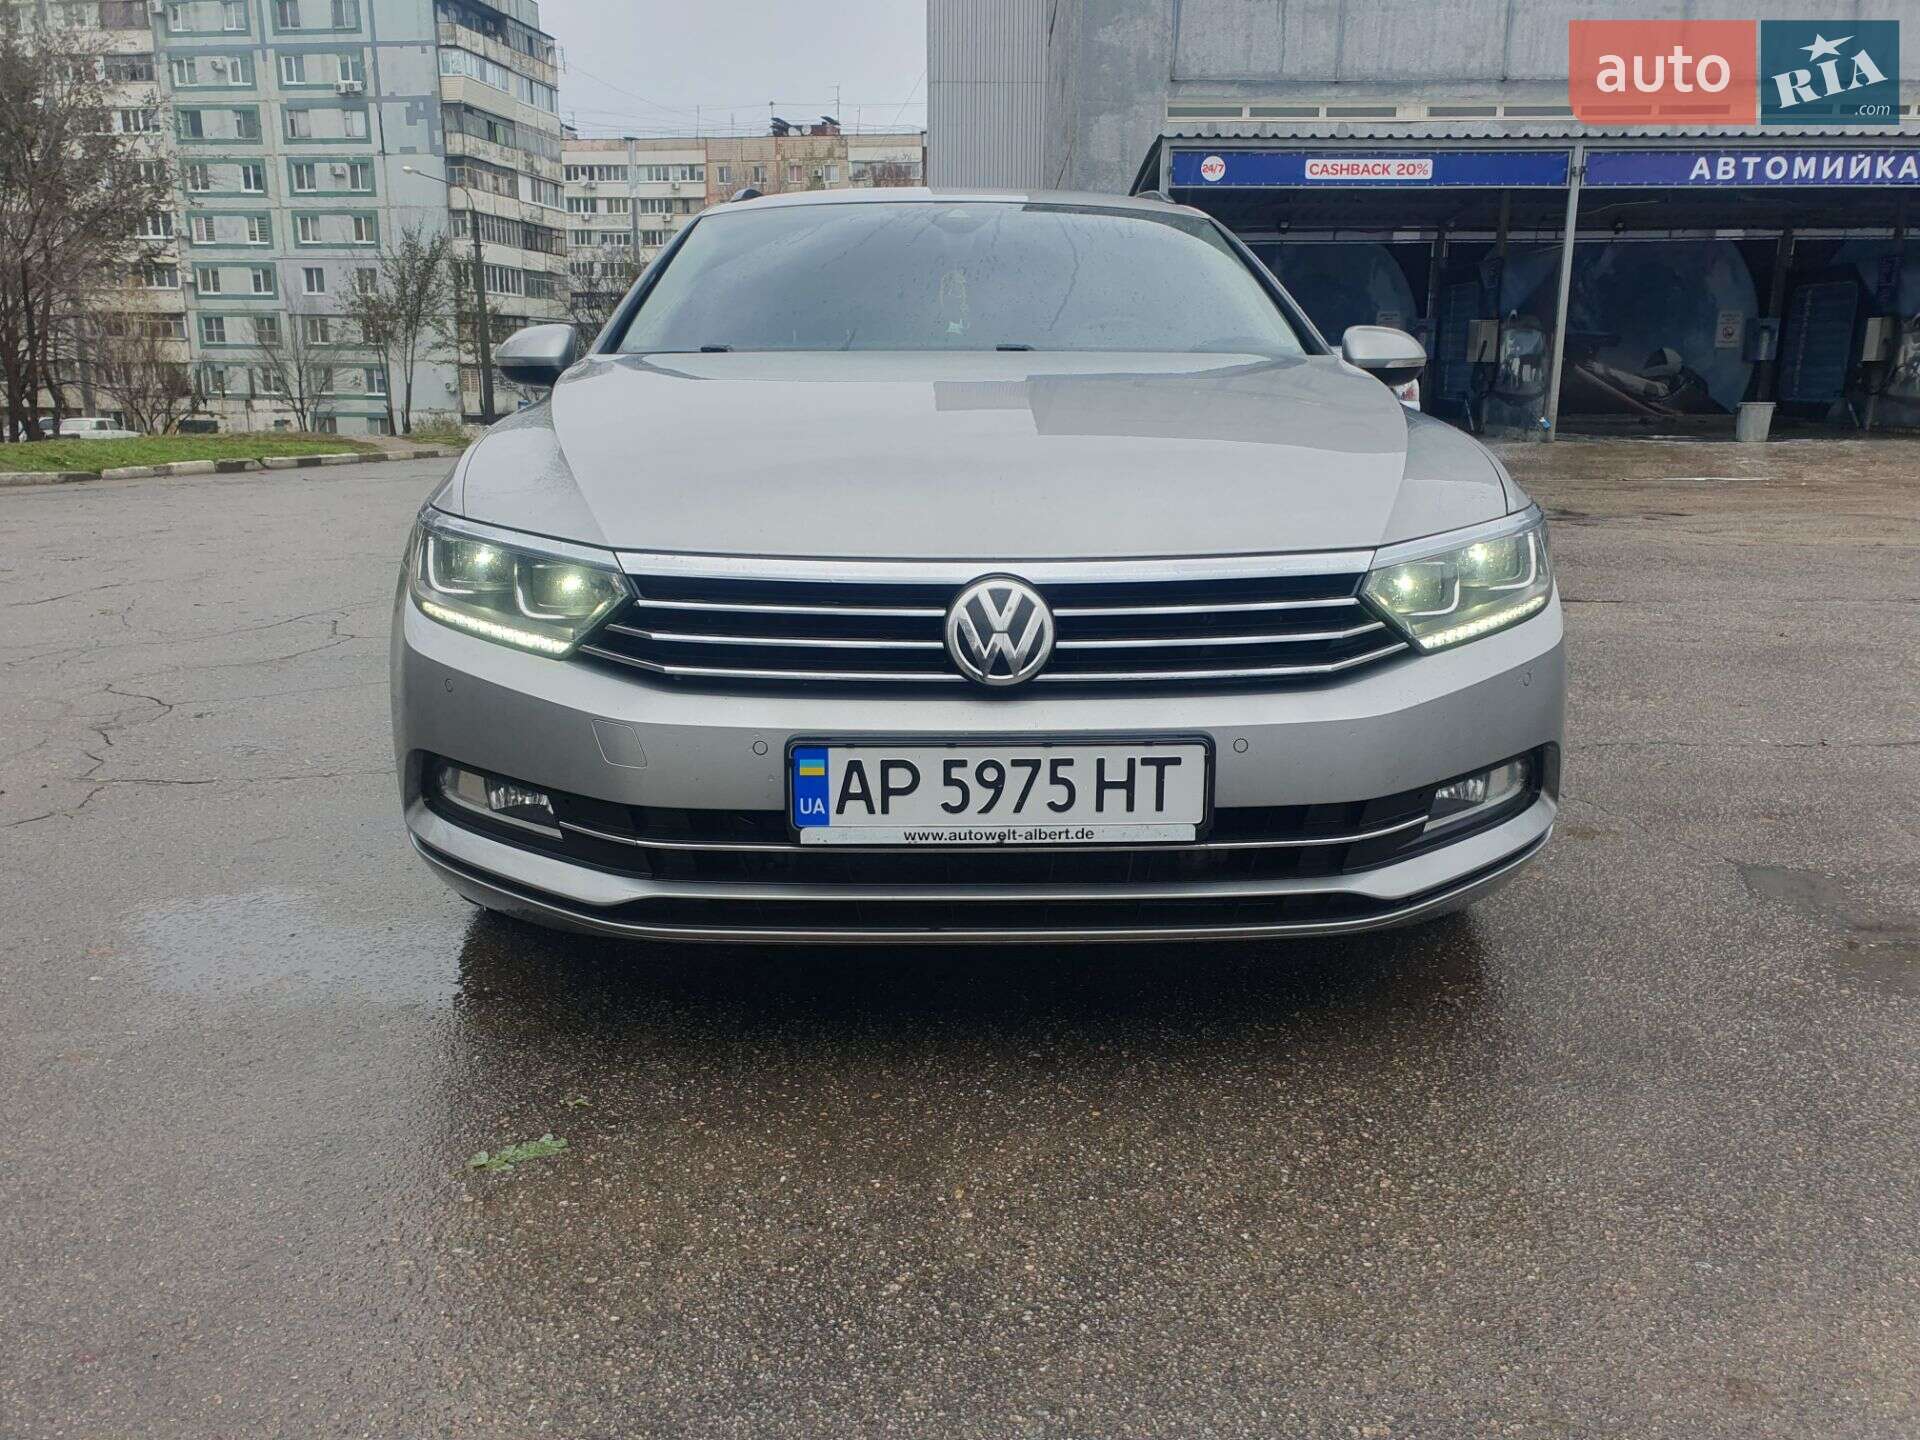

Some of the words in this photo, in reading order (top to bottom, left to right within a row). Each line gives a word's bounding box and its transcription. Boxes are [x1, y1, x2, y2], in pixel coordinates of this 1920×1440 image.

[1202, 163, 1225, 174] 24/7
[1308, 163, 1391, 176] CASHBACK
[1396, 163, 1429, 176] 20%
[1689, 154, 1919, 180] АВТОМИЙКА
[835, 758, 921, 815] AP
[940, 758, 1076, 815] 5975
[1095, 756, 1182, 813] HT
[800, 798, 825, 815] UA
[903, 827, 1095, 844] www.autowelt-albert.de
